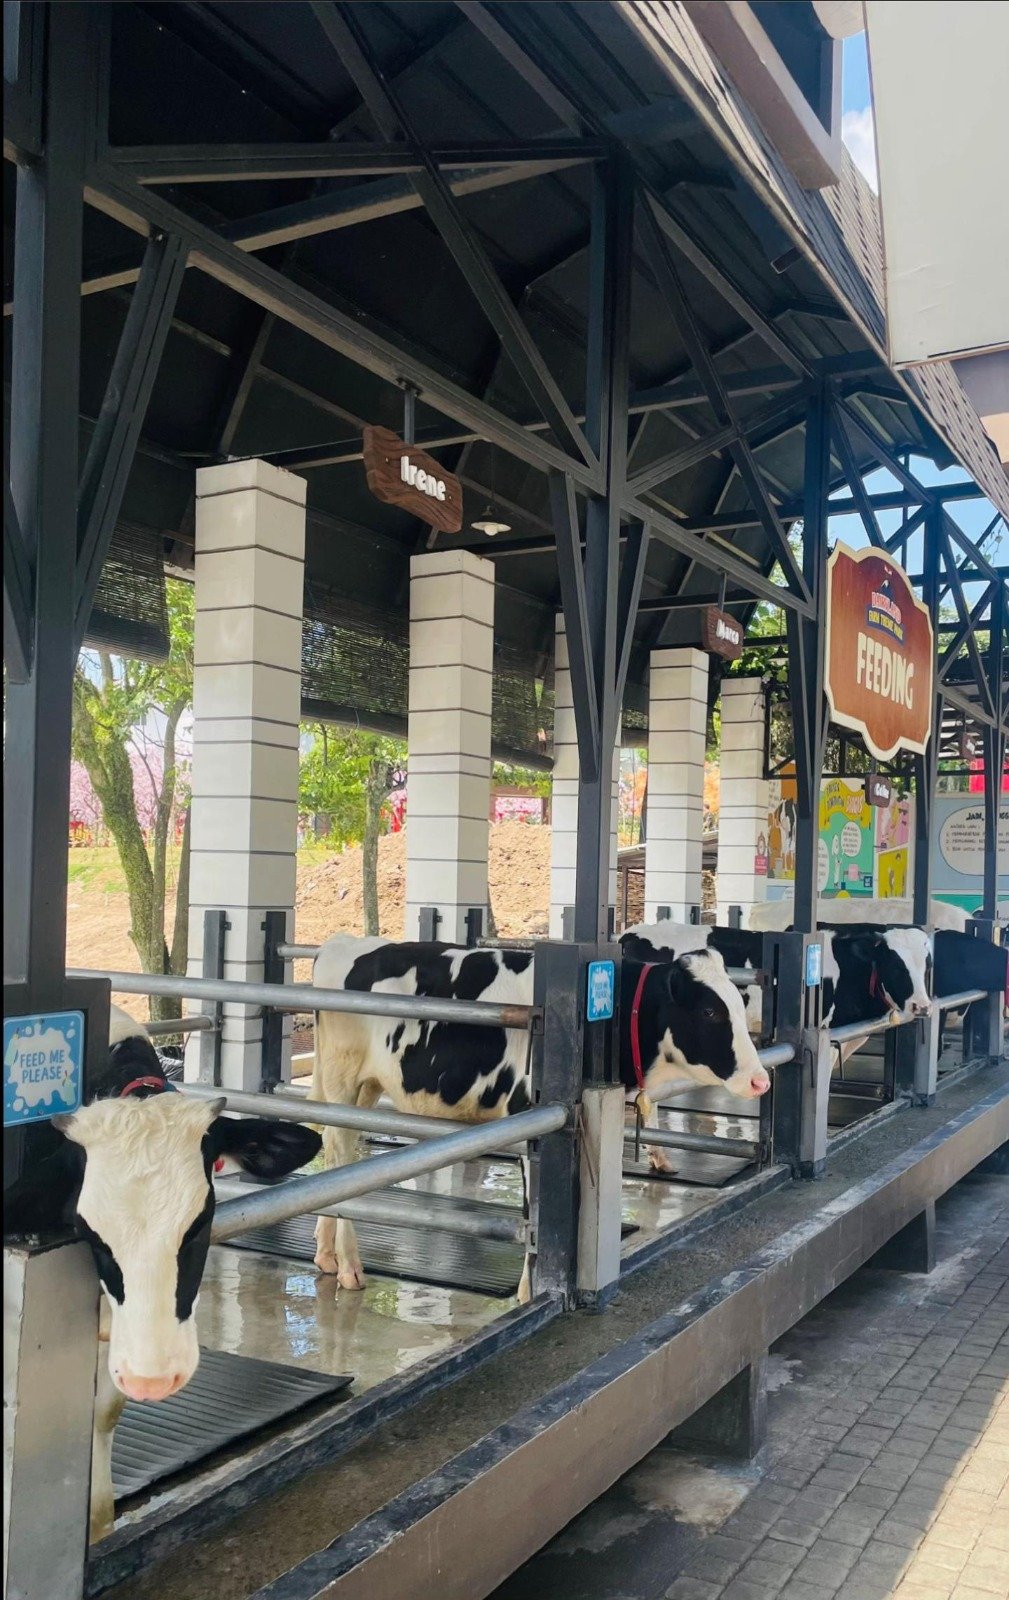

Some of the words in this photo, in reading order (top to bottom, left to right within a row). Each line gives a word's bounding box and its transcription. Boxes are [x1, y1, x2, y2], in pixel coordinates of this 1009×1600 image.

[400, 455, 446, 501] Irene
[856, 631, 914, 710] FEEDING
[20, 1051, 46, 1069] FEED
[49, 1050, 65, 1064] ME
[22, 1066, 62, 1084] PLEASE
